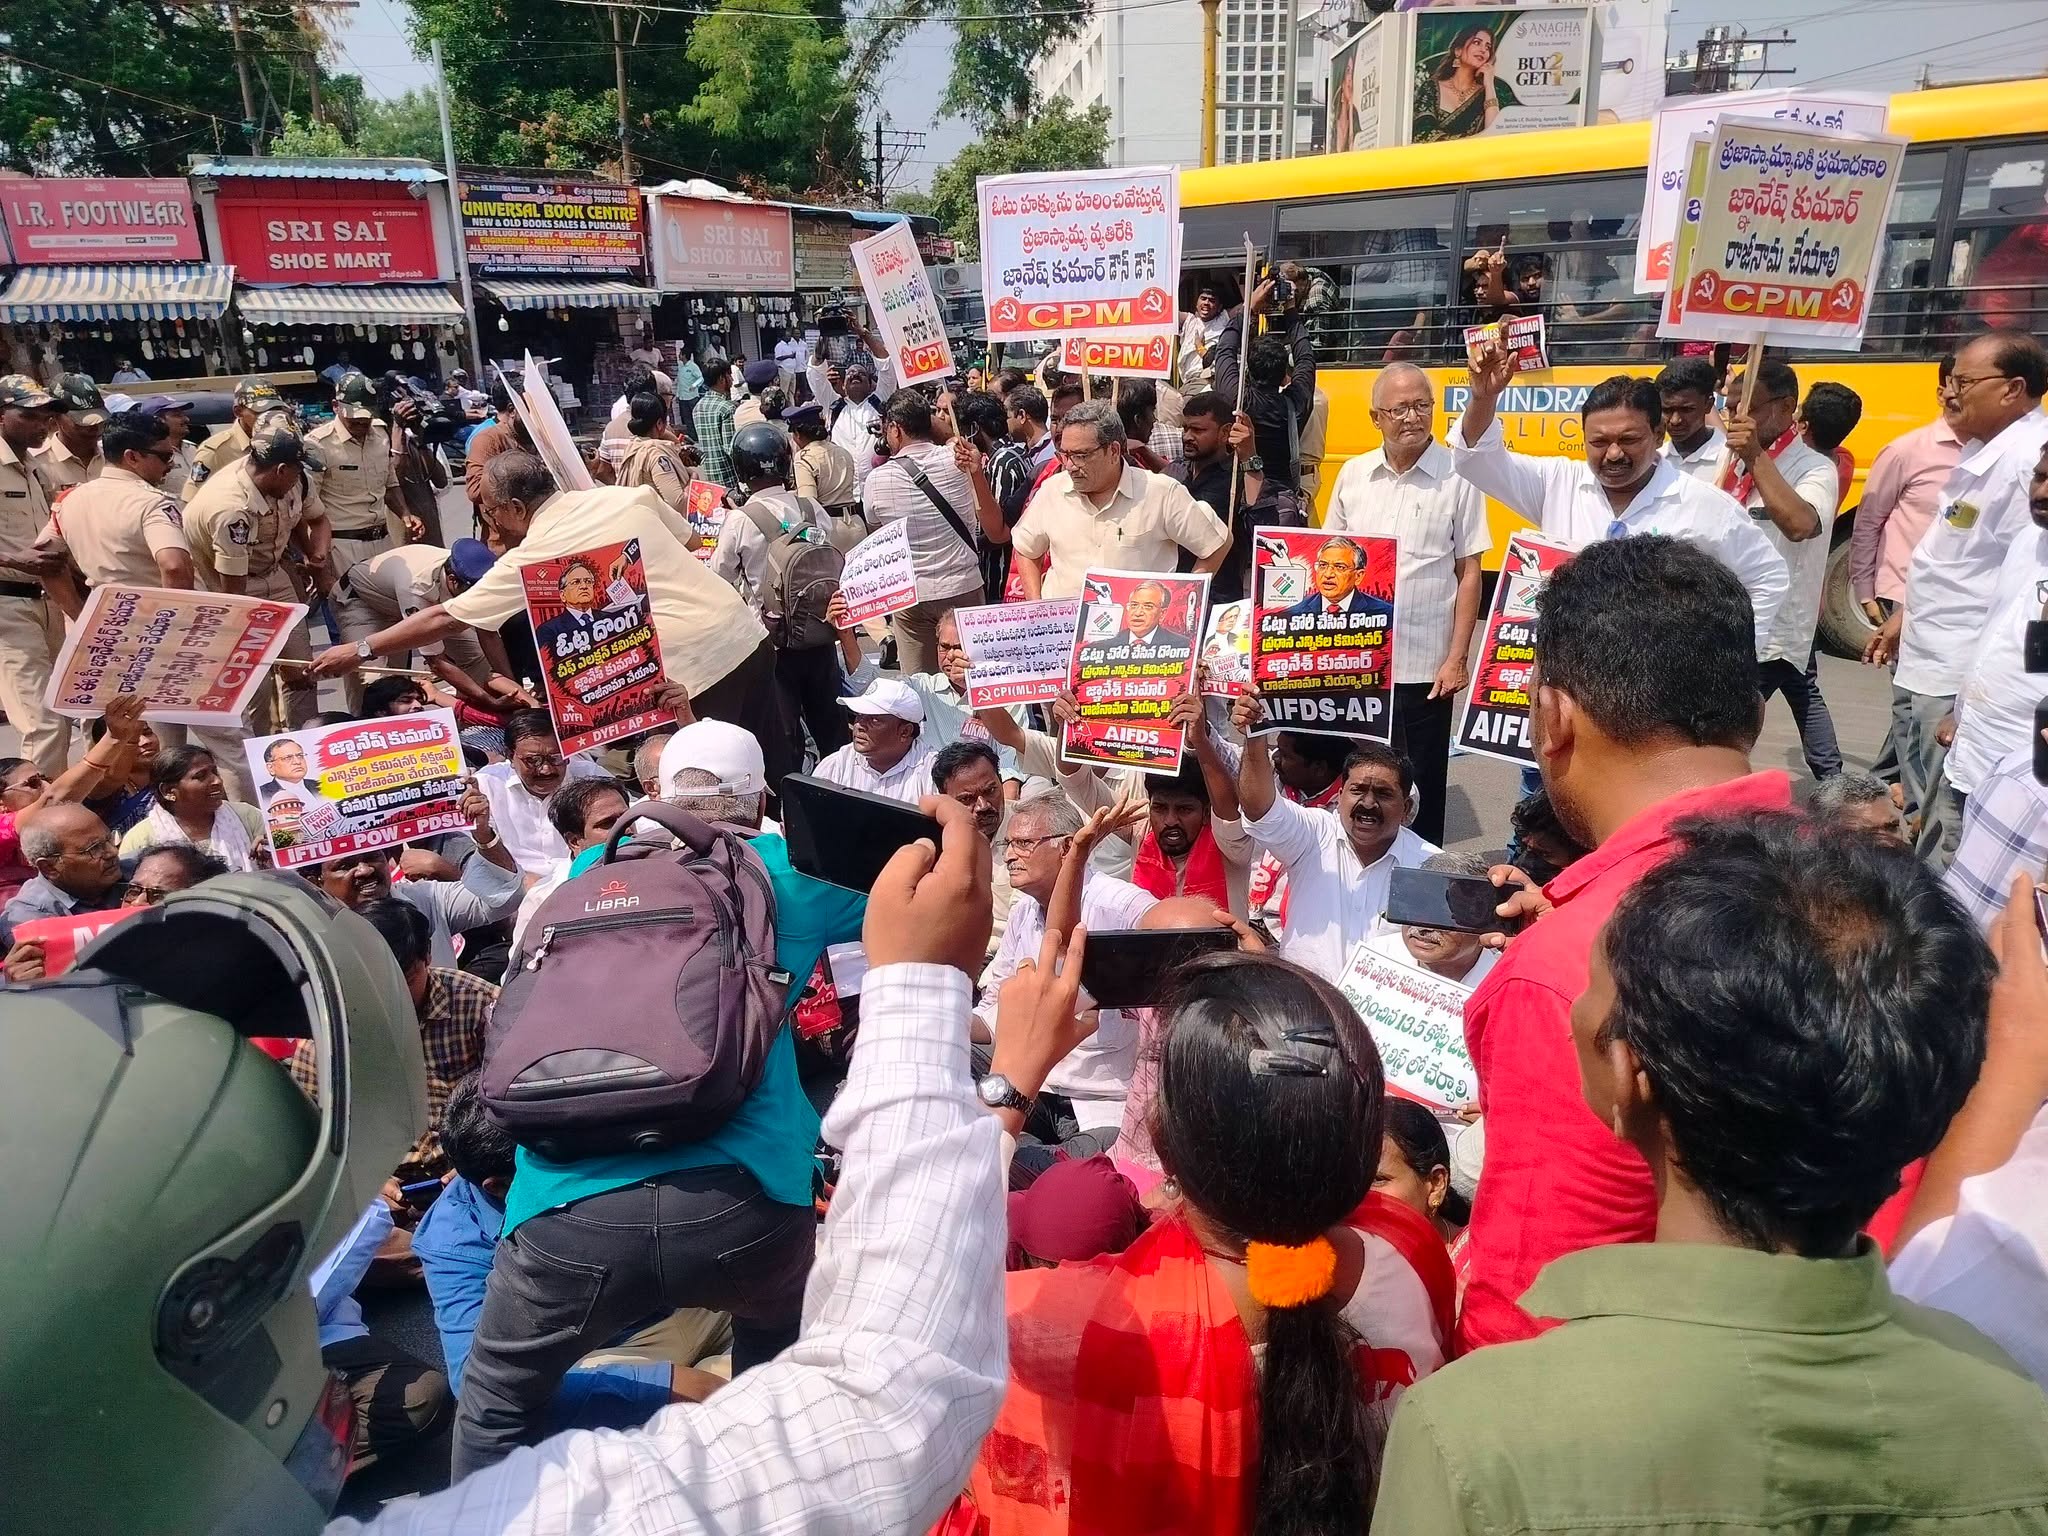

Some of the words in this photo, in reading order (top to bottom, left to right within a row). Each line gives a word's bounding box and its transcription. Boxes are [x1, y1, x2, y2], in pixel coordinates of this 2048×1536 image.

[1529, 22, 1581, 36] ANAGHA
[1518, 57, 1549, 70] BUY
[1550, 51, 1564, 71] 2
[1516, 72, 1551, 87] GET
[1562, 70, 1581, 78] FREE
[1720, 138, 1815, 177] ప్రజాస్వామ్యానికి
[1815, 150, 1887, 181] ప్రమాదకారి
[462, 201, 540, 218] UNIVERSAL
[544, 204, 584, 219] BOOK
[587, 205, 638, 221] CENTRE
[992, 194, 1018, 216] ఓటు
[1021, 191, 1072, 219] హక్కును
[1075, 185, 1165, 215] హరించివేస్తున్న
[1791, 185, 1863, 225] కుమార్
[13, 201, 54, 228] I.R.
[60, 200, 188, 229] FOOTWEAR
[472, 217, 493, 226] NEW
[503, 218, 521, 227] OLD
[522, 219, 552, 228] BOOKS
[553, 220, 579, 229] SALES
[588, 221, 631, 231] PURCHASE
[267, 221, 325, 242] SRI
[333, 221, 388, 242] SAI
[703, 225, 736, 246] SRI
[741, 228, 769, 246] SAI
[1022, 224, 1087, 254] ప్రజాస్వామ్య
[1091, 219, 1134, 251] వ్యతిరేకి
[269, 253, 329, 269] SHOE
[334, 252, 392, 269] MART
[690, 247, 736, 264] SHOE
[741, 250, 784, 267] MART
[1788, 228, 1840, 278] చేయాలి
[1052, 257, 1105, 284] కుమార్
[1109, 250, 1130, 283] డౌన్
[1135, 248, 1155, 281] డౌన్
[1723, 284, 1824, 318] CPM
[1027, 301, 1131, 328] CPM
[1469, 327, 1500, 343] GYANES
[1509, 320, 1539, 335] KUMAR
[1507, 334, 1534, 349] ESIGN
[1086, 344, 1145, 367] CPM
[628, 543, 639, 555] ECI
[610, 581, 623, 594] VOTE
[615, 586, 629, 601] SCAM
[105, 591, 142, 627] కుమార్
[555, 632, 592, 657] ఓట్ల
[592, 609, 639, 642] దొంగ
[1262, 615, 1287, 635] ఓట్లు
[1316, 613, 1347, 631] చేసిన
[1350, 613, 1388, 629] దొంగా
[1498, 623, 1530, 645] ఓట్లు
[611, 626, 652, 655] కమిషనర్
[1262, 636, 1294, 652] ప్రధాన
[1295, 633, 1332, 651] ఎన్నికల
[1333, 630, 1383, 648] కమిషనర్
[218, 627, 275, 690] CPM
[606, 650, 640, 676] కుమార్
[1214, 655, 1236, 667] RESIGN
[1317, 651, 1373, 671] కుమార్
[1497, 645, 1535, 660] ప్రధాన
[118, 646, 155, 693] రాజీనామా
[1081, 664, 1110, 679] ప్రధాన
[1111, 664, 1141, 677] ఎన్నికల
[1142, 662, 1184, 676] కమిషనర్
[1217, 662, 1235, 673] NOW
[581, 677, 625, 704] రాజీనామా
[993, 683, 1036, 698] CPI(ML)
[1124, 680, 1167, 697] కుమార్
[1200, 682, 1228, 694] FTU
[1263, 677, 1321, 691] రాజీనామా
[563, 712, 583, 723] DYFI
[1257, 697, 1383, 724] AIFDS-AP
[388, 721, 445, 746] కుమార్
[592, 724, 620, 742] DYFI
[628, 716, 644, 731] AP
[1104, 725, 1159, 744] AIFDS
[327, 766, 367, 784] ఎన్నికల
[371, 754, 417, 775] కమిషనర్
[420, 748, 455, 766] తక్షణమే
[344, 772, 405, 793] రాజీనామా
[408, 765, 453, 785] చేయాలి.
[341, 796, 378, 815] సమగ్ర
[379, 787, 421, 811] విచారణ
[304, 804, 333, 826] RESIGN
[313, 813, 336, 831] NOW
[287, 840, 333, 863] IFTU
[353, 827, 399, 849] POW
[417, 813, 466, 833] PDSU
[583, 895, 640, 912] LIBRA
[1395, 1012, 1428, 1038] 13.5
[1406, 1055, 1429, 1075] లో
